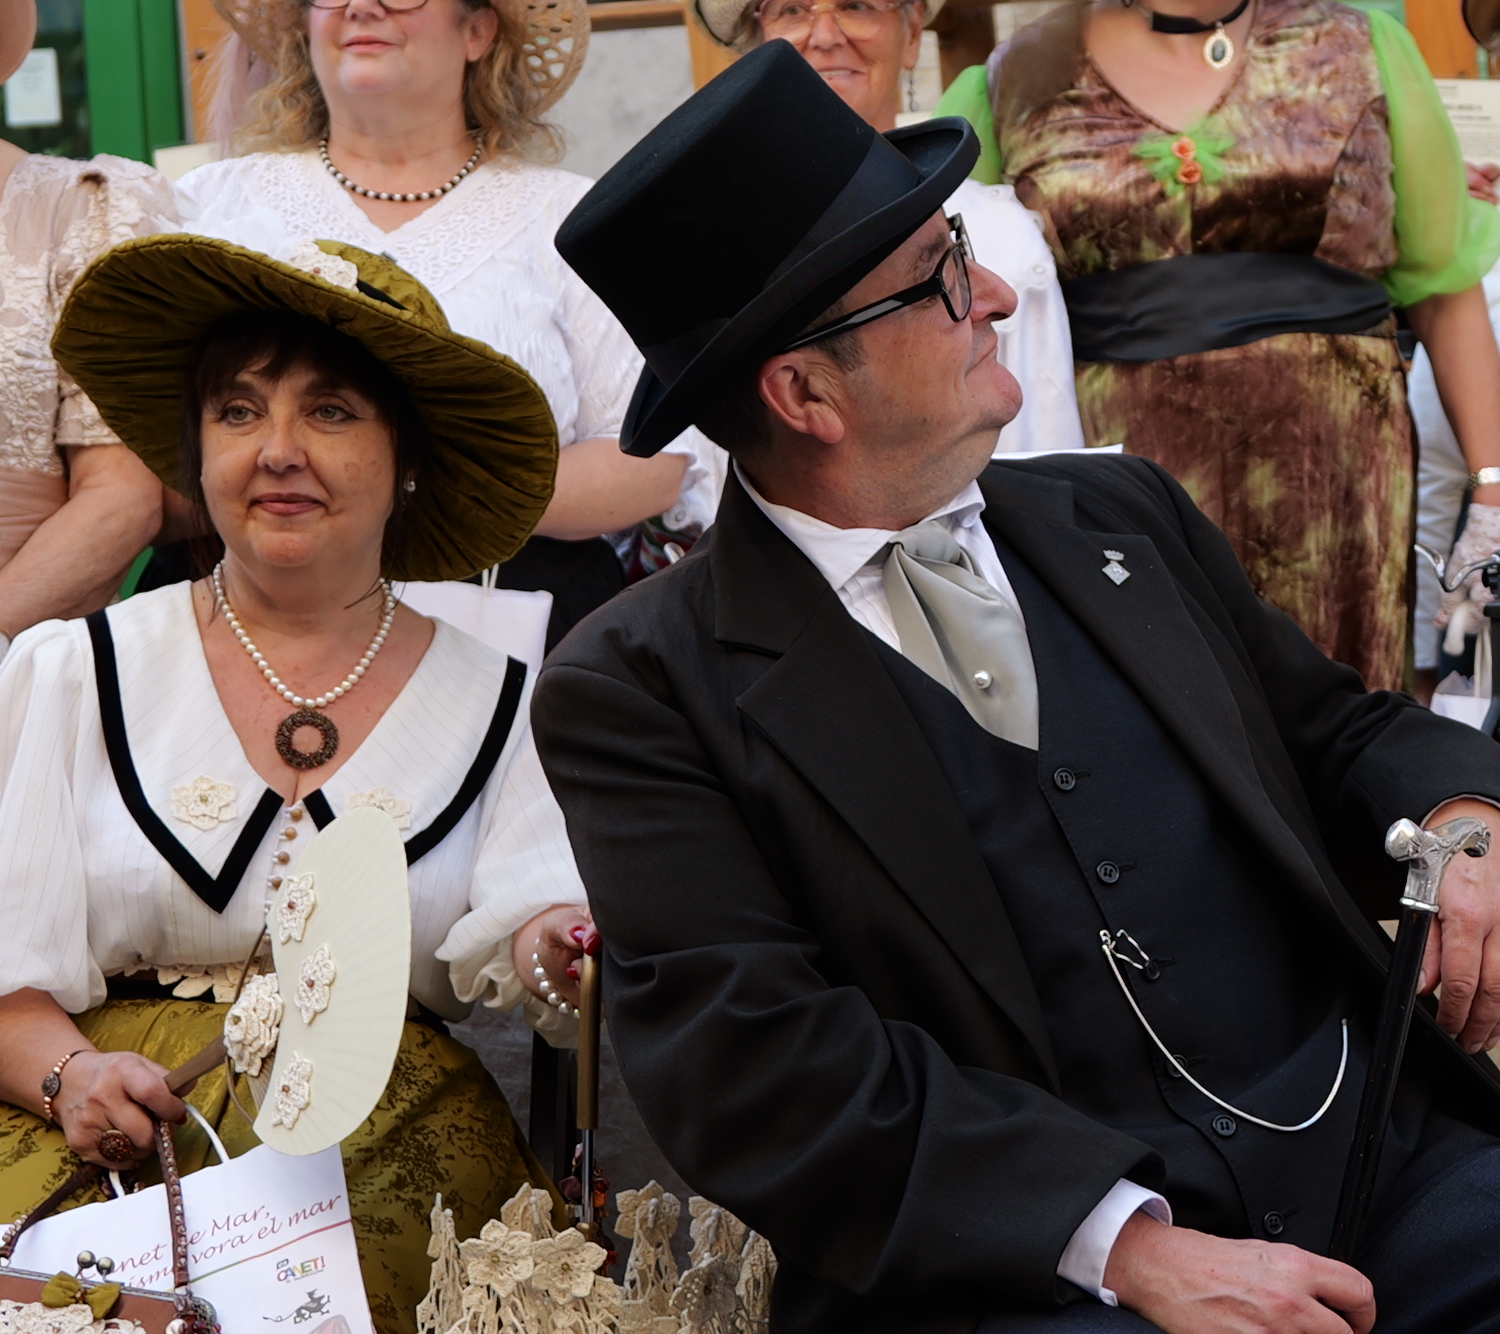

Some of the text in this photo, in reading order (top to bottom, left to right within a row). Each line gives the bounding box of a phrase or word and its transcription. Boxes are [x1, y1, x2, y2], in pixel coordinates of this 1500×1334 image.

[191, 1195, 341, 1265] vora el mar
[211, 1204, 269, 1237] Mar,
[277, 1255, 326, 1282] CANET!
